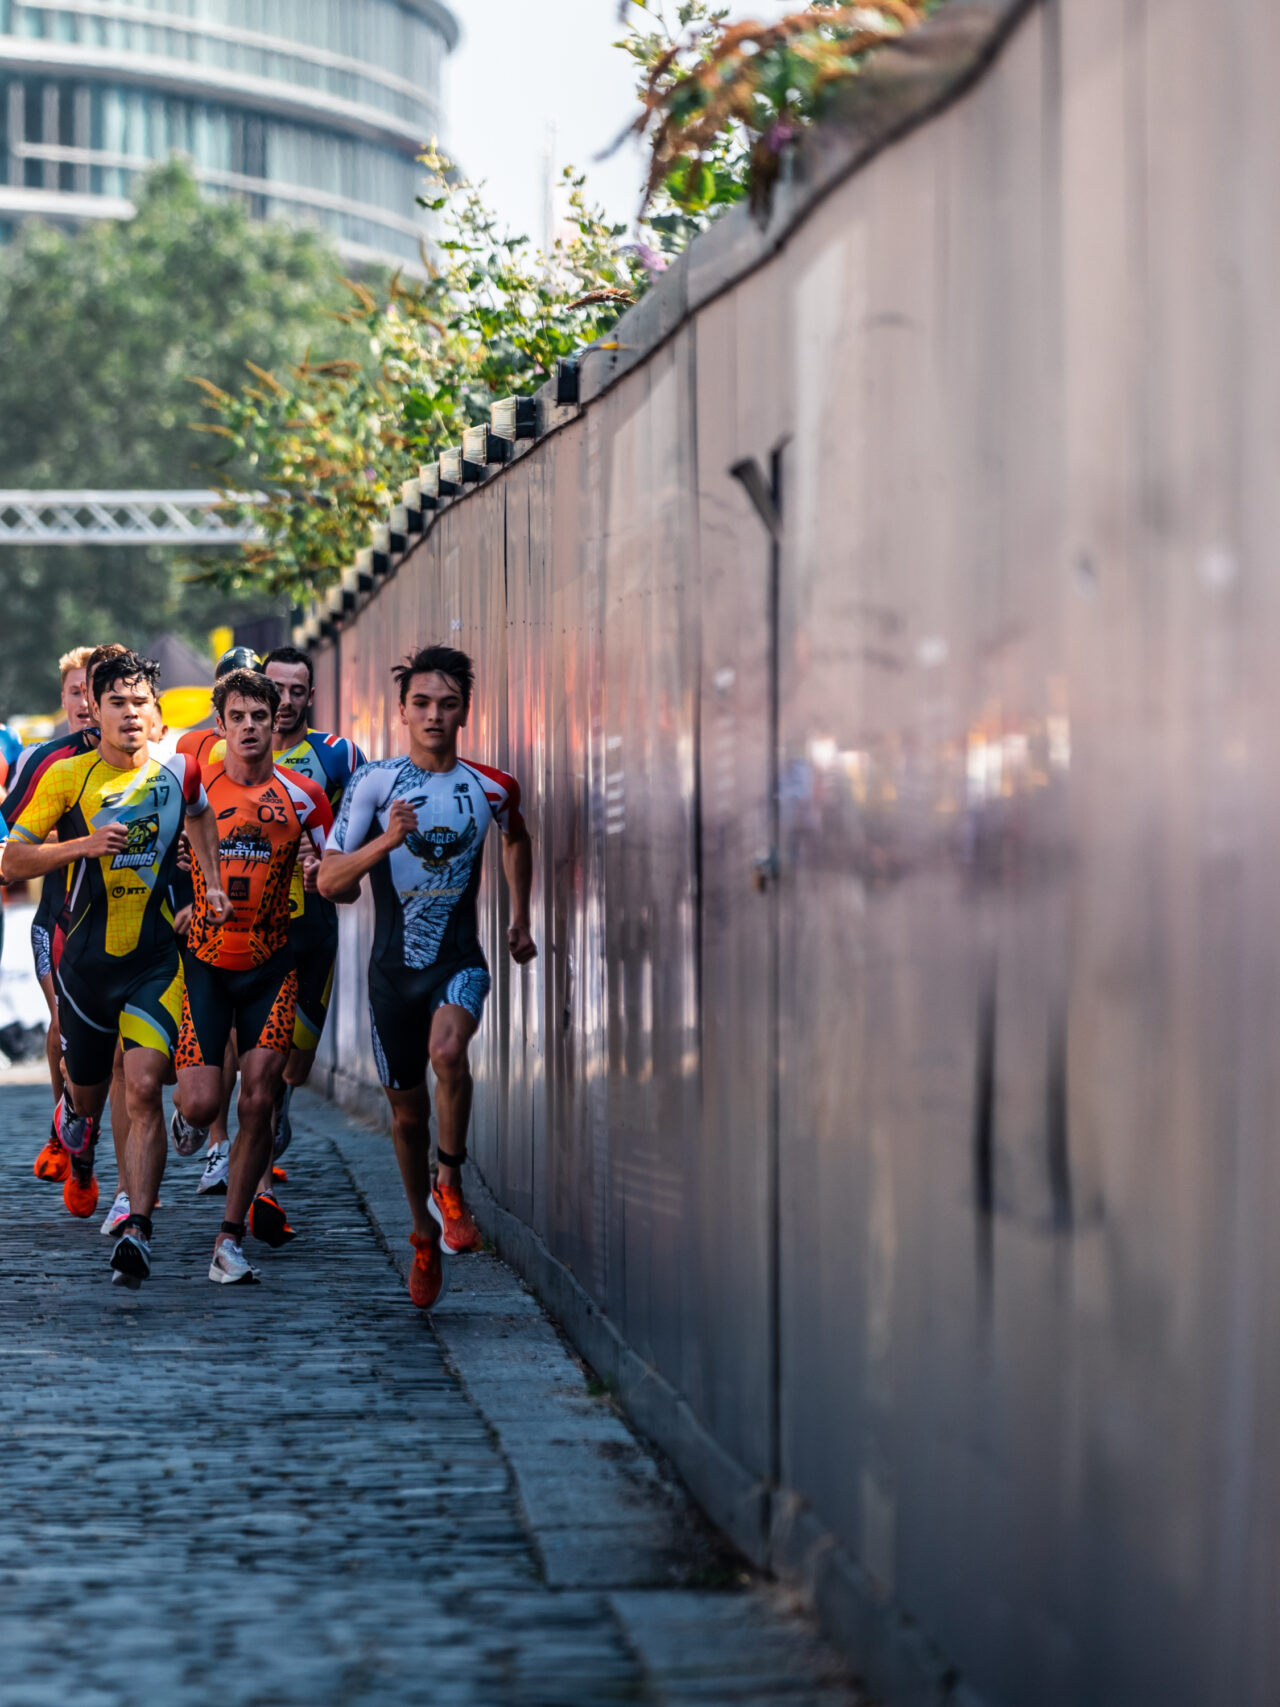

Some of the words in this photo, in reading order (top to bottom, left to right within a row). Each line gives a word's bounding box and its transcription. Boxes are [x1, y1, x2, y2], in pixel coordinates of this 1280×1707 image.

[149, 785, 170, 808] 17
[453, 794, 474, 815] 11
[257, 804, 288, 825] 03
[235, 841, 254, 850] SLT
[425, 832, 457, 844] EAGLES
[128, 846, 146, 854] SLT
[218, 847, 271, 863] CHEETAHS
[111, 851, 157, 870] RHINOS
[127, 886, 147, 895] NTT
